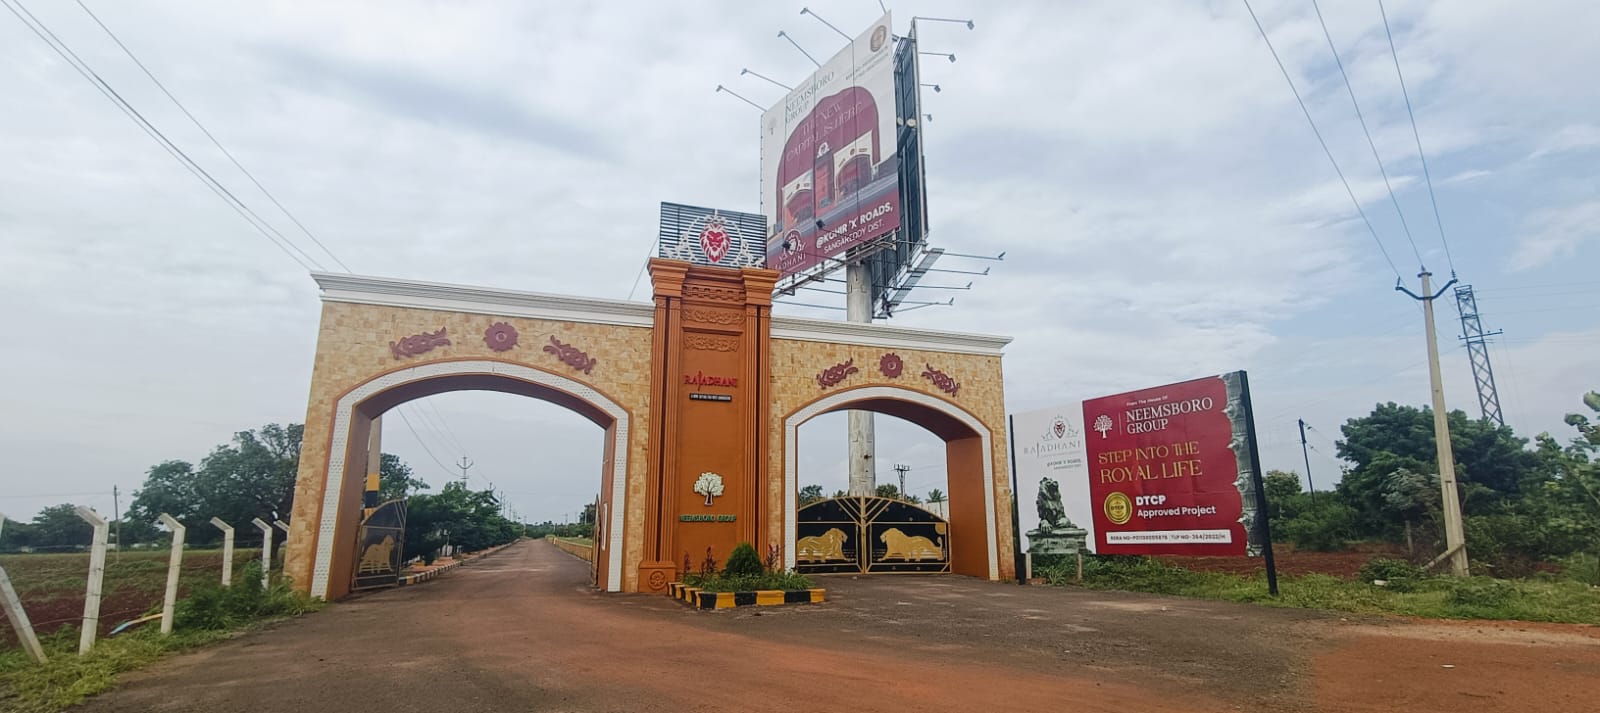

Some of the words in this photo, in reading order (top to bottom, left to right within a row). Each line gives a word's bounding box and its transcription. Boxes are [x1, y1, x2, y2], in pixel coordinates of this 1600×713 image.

[860, 202, 893, 225] ROADS,
[823, 226, 867, 254] SANGAREDDY
[684, 370, 737, 391] RAJADHANI
[1126, 396, 1213, 423] NEEMSBORO
[1126, 418, 1168, 434] GROUP
[1023, 440, 1080, 458] RAJADHANI
[1098, 449, 1132, 464] STEP
[1135, 445, 1169, 460] INTO
[1172, 441, 1200, 456] THE
[1100, 464, 1158, 484] ROYAL
[1162, 459, 1203, 478] LIFE
[1135, 494, 1167, 506] DTCP
[1137, 507, 1180, 519] Approved
[1181, 505, 1217, 517] Project
